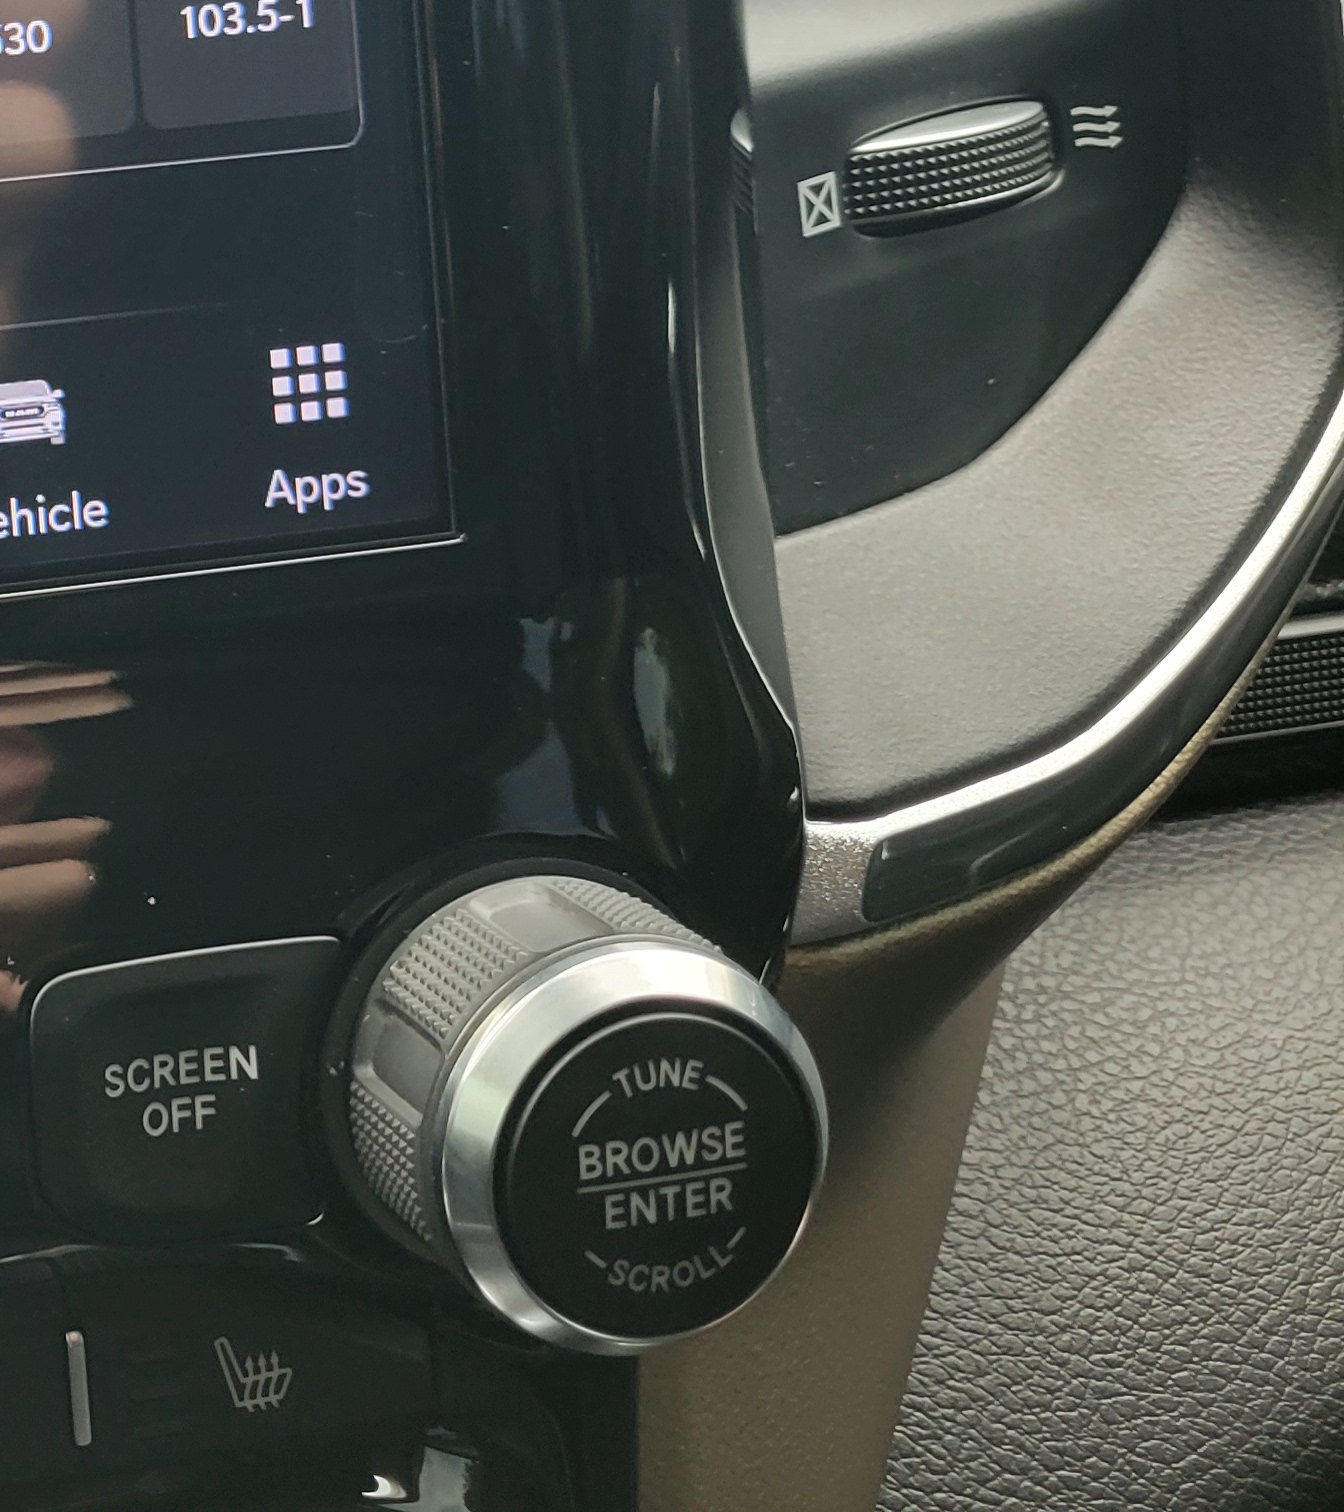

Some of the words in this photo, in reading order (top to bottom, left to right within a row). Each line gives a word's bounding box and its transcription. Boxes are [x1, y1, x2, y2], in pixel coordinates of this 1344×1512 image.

[264, 468, 369, 514] Apps
[104, 1044, 260, 1099] SCREEN
[611, 1058, 705, 1100] TUNE
[142, 1096, 217, 1138] OFF
[578, 1121, 748, 1181] BROWSE
[603, 1178, 735, 1230] ENTER
[606, 1246, 732, 1293] SCROLL
